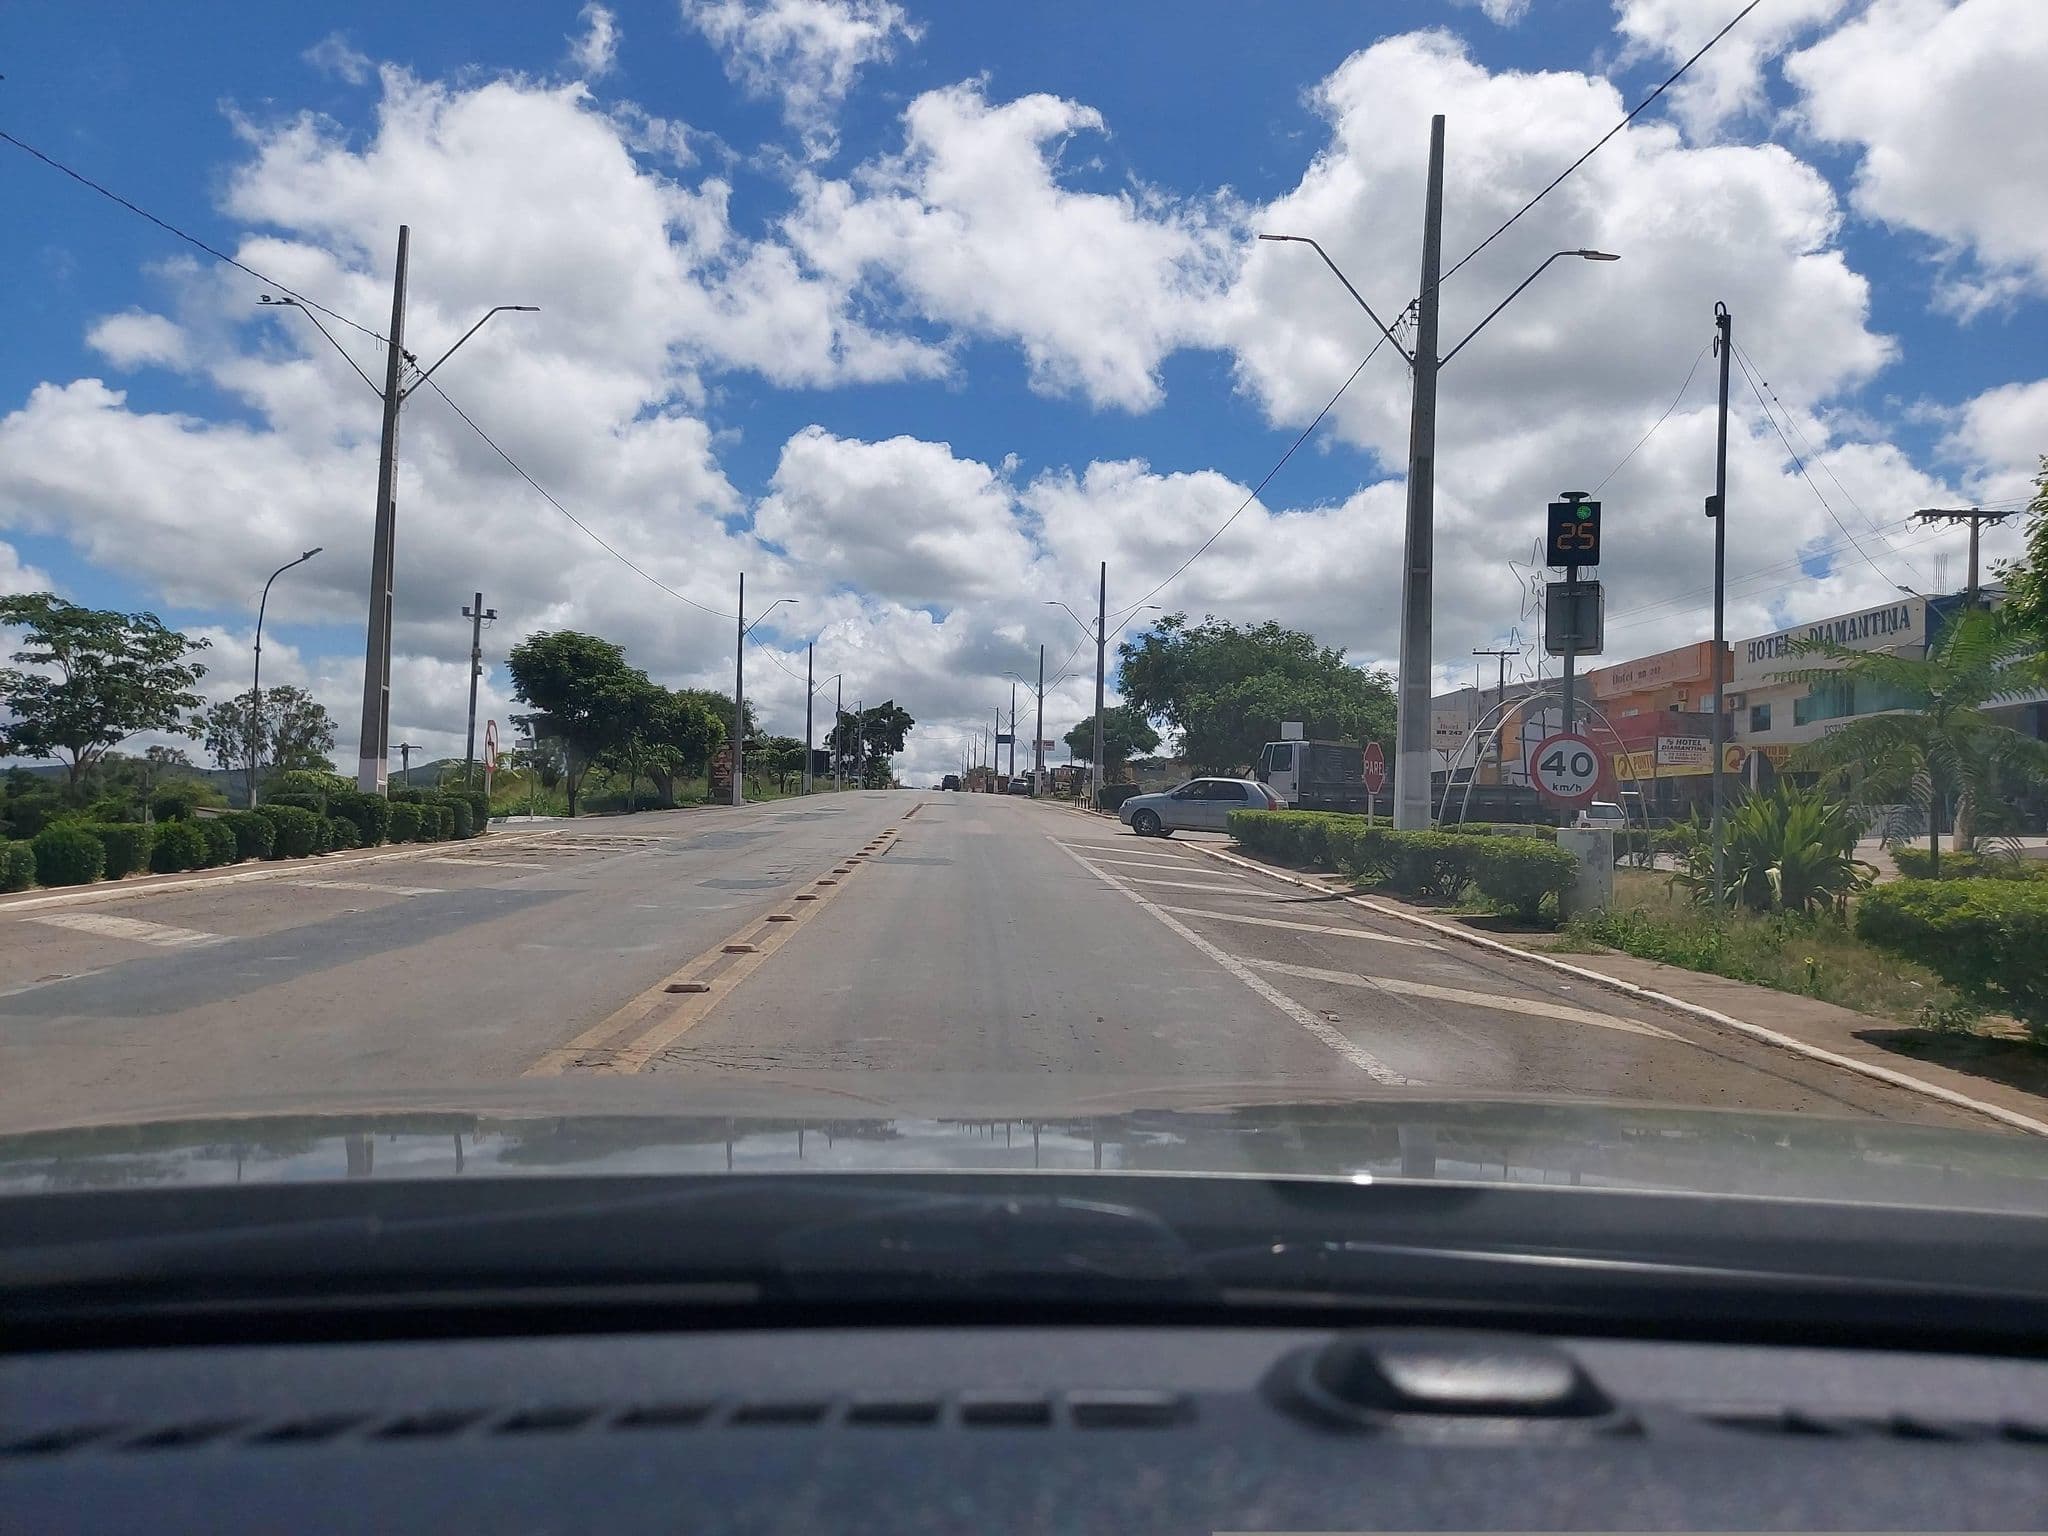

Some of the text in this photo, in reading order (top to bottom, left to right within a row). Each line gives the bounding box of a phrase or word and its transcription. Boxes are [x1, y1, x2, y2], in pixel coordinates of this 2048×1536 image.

[1556, 522, 1595, 550] 25
[1747, 605, 1911, 663] HOTEL DIAMANTINA
[1660, 744, 1707, 752] DIAMANTINA
[1364, 760, 1383, 775] PARE
[1541, 751, 1593, 777] 40
[1552, 783, 1582, 792] km/h
